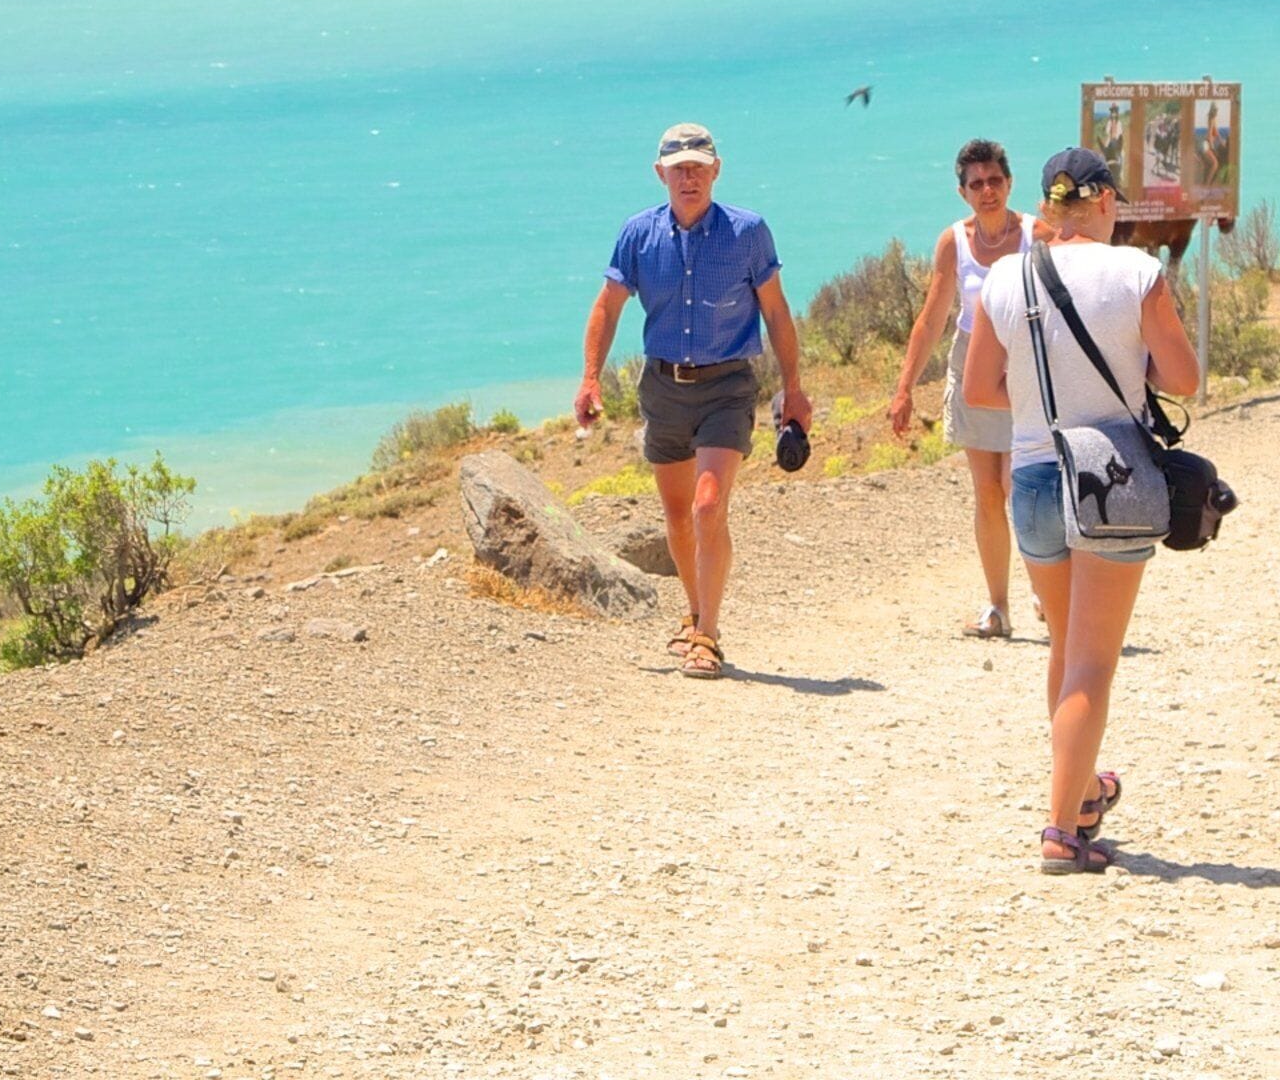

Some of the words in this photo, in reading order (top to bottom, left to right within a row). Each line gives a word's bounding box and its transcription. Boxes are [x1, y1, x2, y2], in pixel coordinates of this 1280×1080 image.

[1095, 84, 1134, 97] welcome
[1139, 85, 1149, 97] to
[1154, 84, 1195, 97] THERMA
[1199, 85, 1209, 97] of
